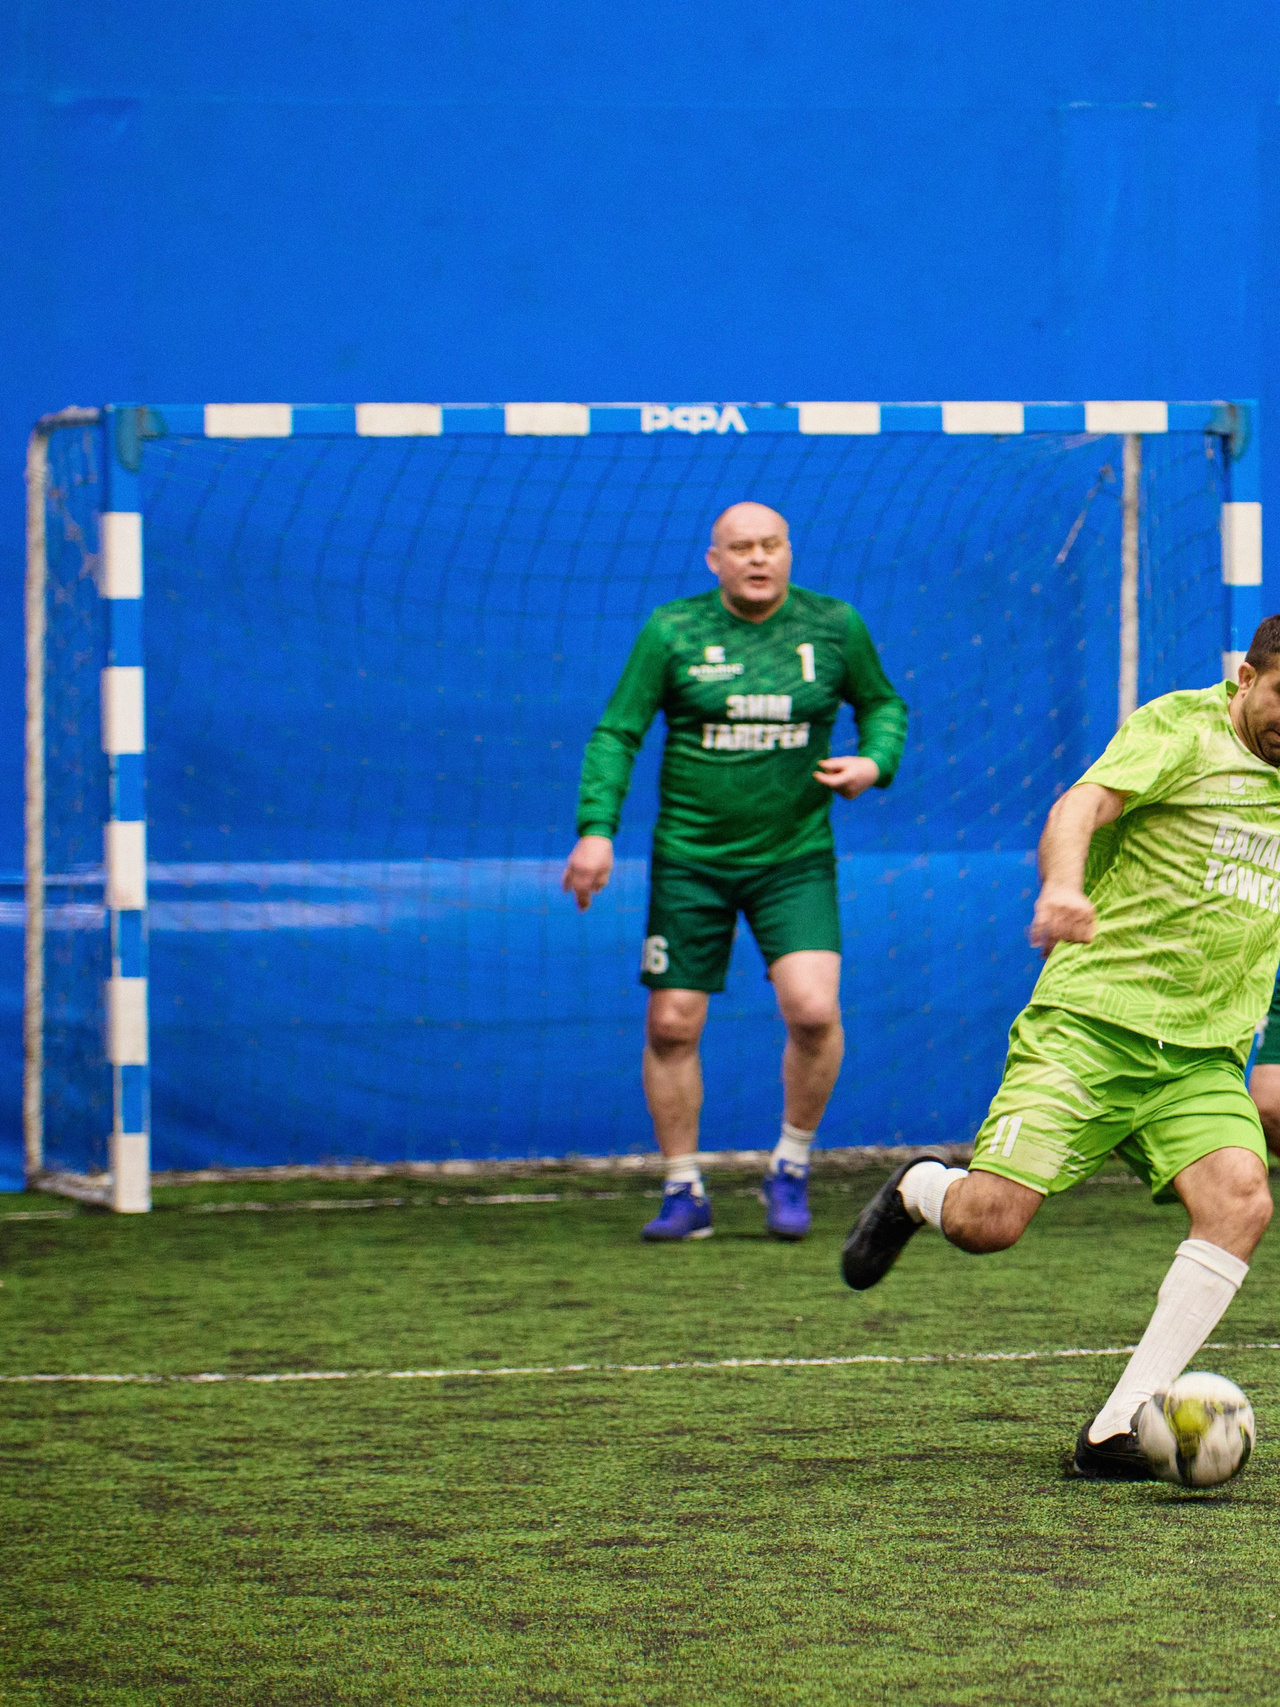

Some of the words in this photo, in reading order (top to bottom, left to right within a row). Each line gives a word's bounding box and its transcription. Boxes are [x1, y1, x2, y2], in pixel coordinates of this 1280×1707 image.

[641, 405, 748, 434] РФЛ
[796, 643, 816, 682] 1
[988, 1115, 1023, 1157] 11
